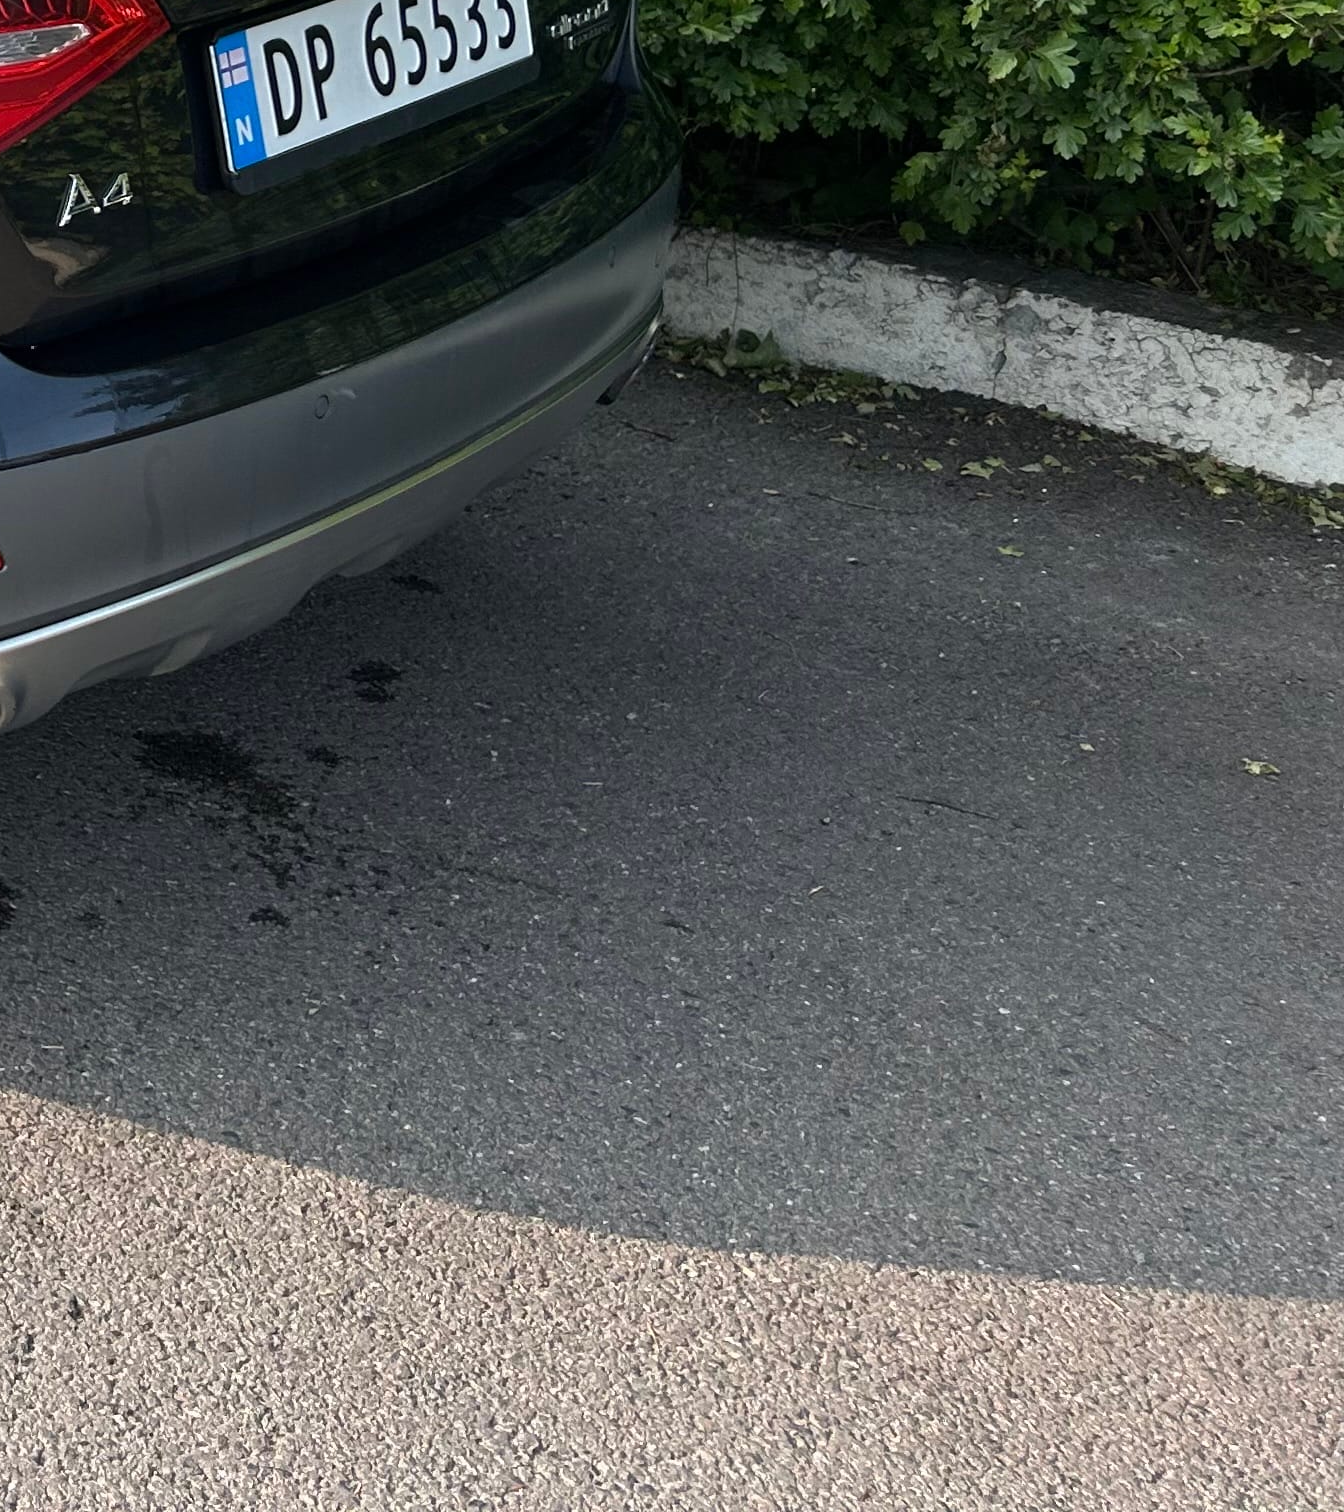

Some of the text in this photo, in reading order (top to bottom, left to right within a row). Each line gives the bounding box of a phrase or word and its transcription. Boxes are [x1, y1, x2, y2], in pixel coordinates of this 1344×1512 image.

[262, 23, 335, 137] DP
[234, 114, 254, 146] N
[56, 172, 133, 227] A4
